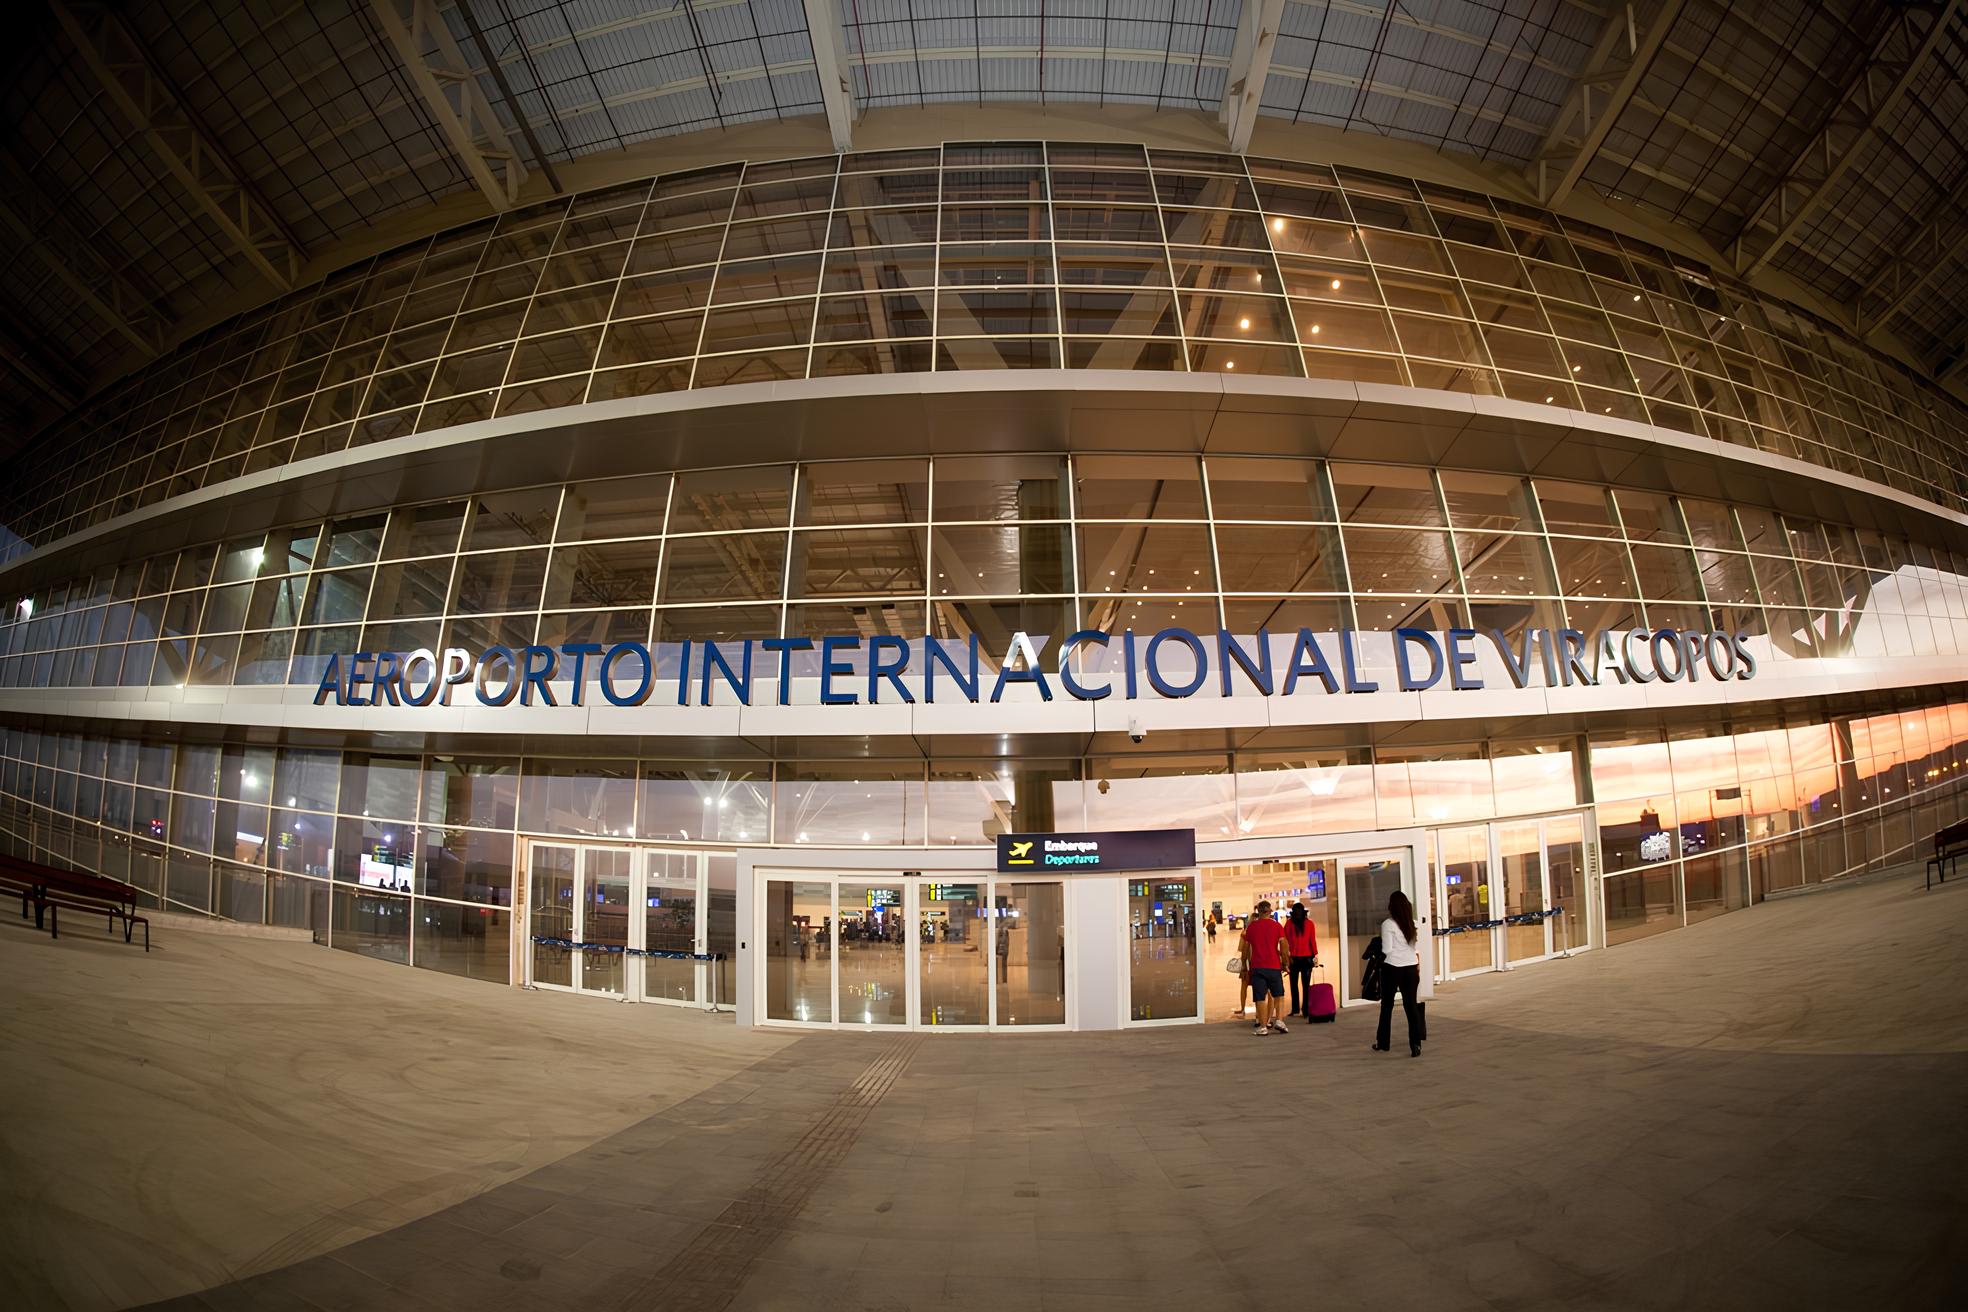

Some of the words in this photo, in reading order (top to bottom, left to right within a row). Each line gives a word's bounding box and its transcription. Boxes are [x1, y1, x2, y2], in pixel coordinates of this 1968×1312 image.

[313, 641, 656, 706] AEROPORTO
[678, 627, 1379, 706] INTERNACIONAL
[1394, 627, 1485, 692] DE
[1492, 627, 1757, 689] VIRACOPOS
[1044, 840, 1098, 853] Embarque
[1045, 854, 1100, 866] Departures
